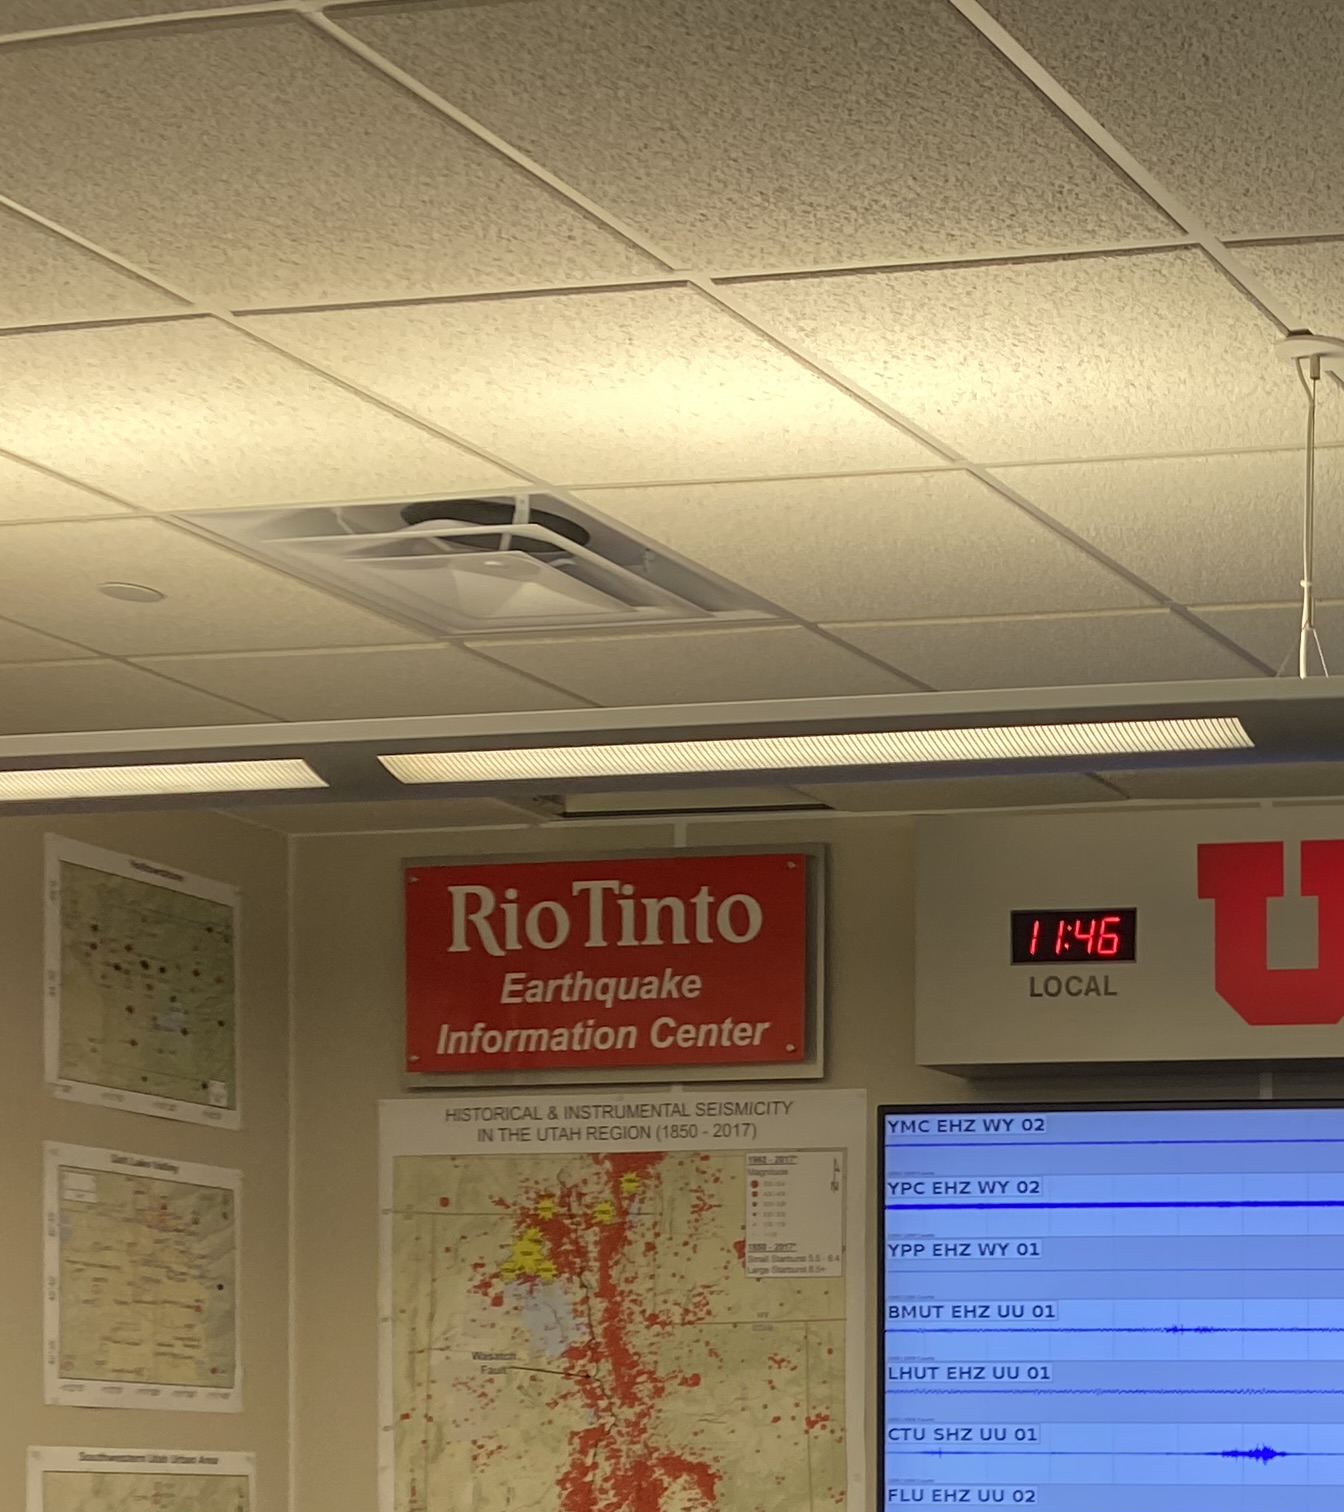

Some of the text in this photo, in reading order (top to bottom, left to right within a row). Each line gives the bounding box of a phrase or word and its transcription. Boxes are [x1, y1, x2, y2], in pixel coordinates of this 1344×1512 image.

[1027, 915, 1121, 956] 11:46
[500, 967, 703, 1009] Earthquake
[1029, 975, 1118, 998] LOCAL
[435, 1015, 772, 1055] Information Center
[445, 1100, 793, 1122] HISTORICAL & INSTRUMENTAL SEISMICITY
[477, 1129, 494, 1142] IN
[498, 1128, 532, 1142] THE
[537, 1126, 582, 1141] UTAH
[586, 1125, 651, 1140] REGION
[656, 1124, 699, 1141] (1850
[713, 1122, 757, 1140] 2017)
[888, 1118, 1045, 1133] YMC EHZ WY 02
[888, 1180, 1040, 1195] YPC EHZ WY 02
[888, 1242, 1040, 1257] YPP EHZ WY 01
[888, 1305, 1056, 1319] BMUT EHZ UU 01
[888, 1366, 1051, 1379] LHUT EHZ UU 01
[888, 1428, 1038, 1441] CTU SHZ UU 01
[888, 1489, 1036, 1503] FLU EHZ UU 02
